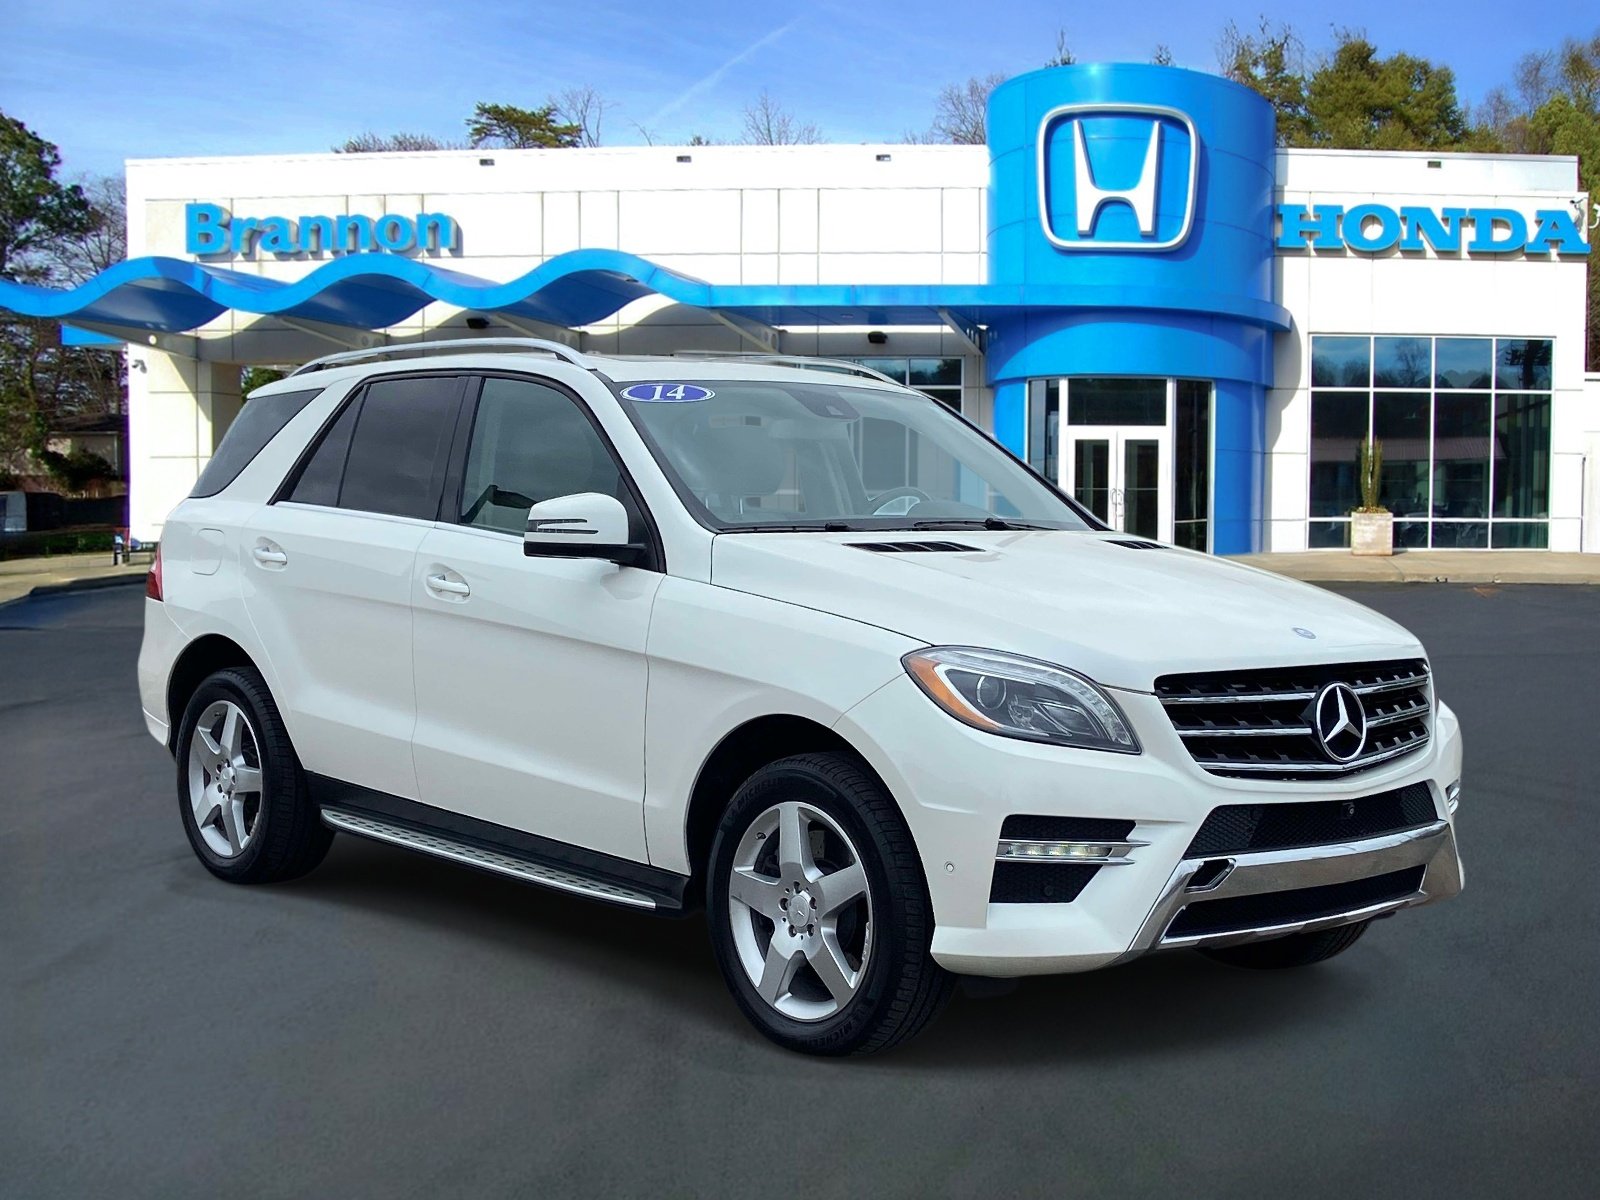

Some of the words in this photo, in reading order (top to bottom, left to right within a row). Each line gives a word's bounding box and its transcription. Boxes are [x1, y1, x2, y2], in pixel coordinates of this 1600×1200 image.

[185, 203, 459, 256] Brannon
[1277, 203, 1592, 254] HONDA
[651, 384, 685, 400] 14
